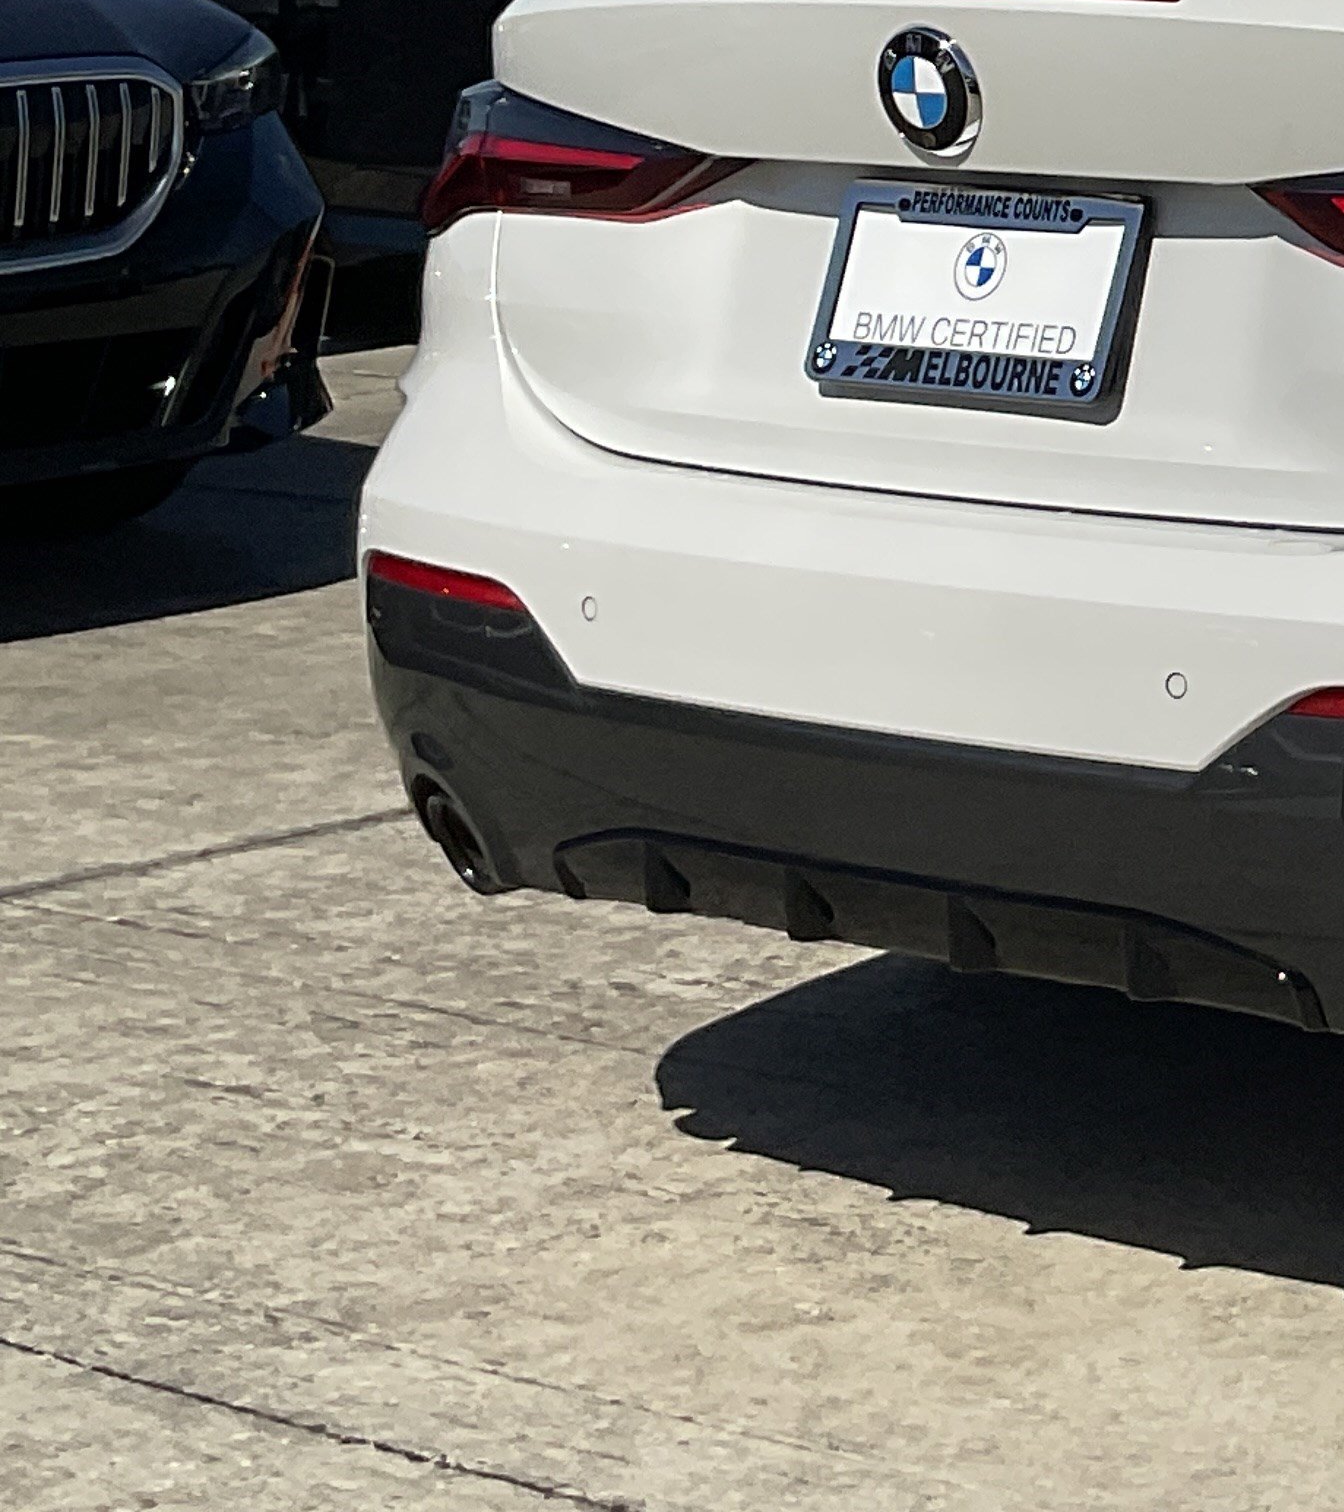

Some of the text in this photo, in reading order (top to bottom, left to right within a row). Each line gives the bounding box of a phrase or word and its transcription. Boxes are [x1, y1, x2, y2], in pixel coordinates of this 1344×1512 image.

[911, 191, 1071, 223] PERFORMANCE COUNTS
[853, 311, 1077, 355] BMW CERTIFIED
[877, 348, 1063, 396] MELBOURNE
